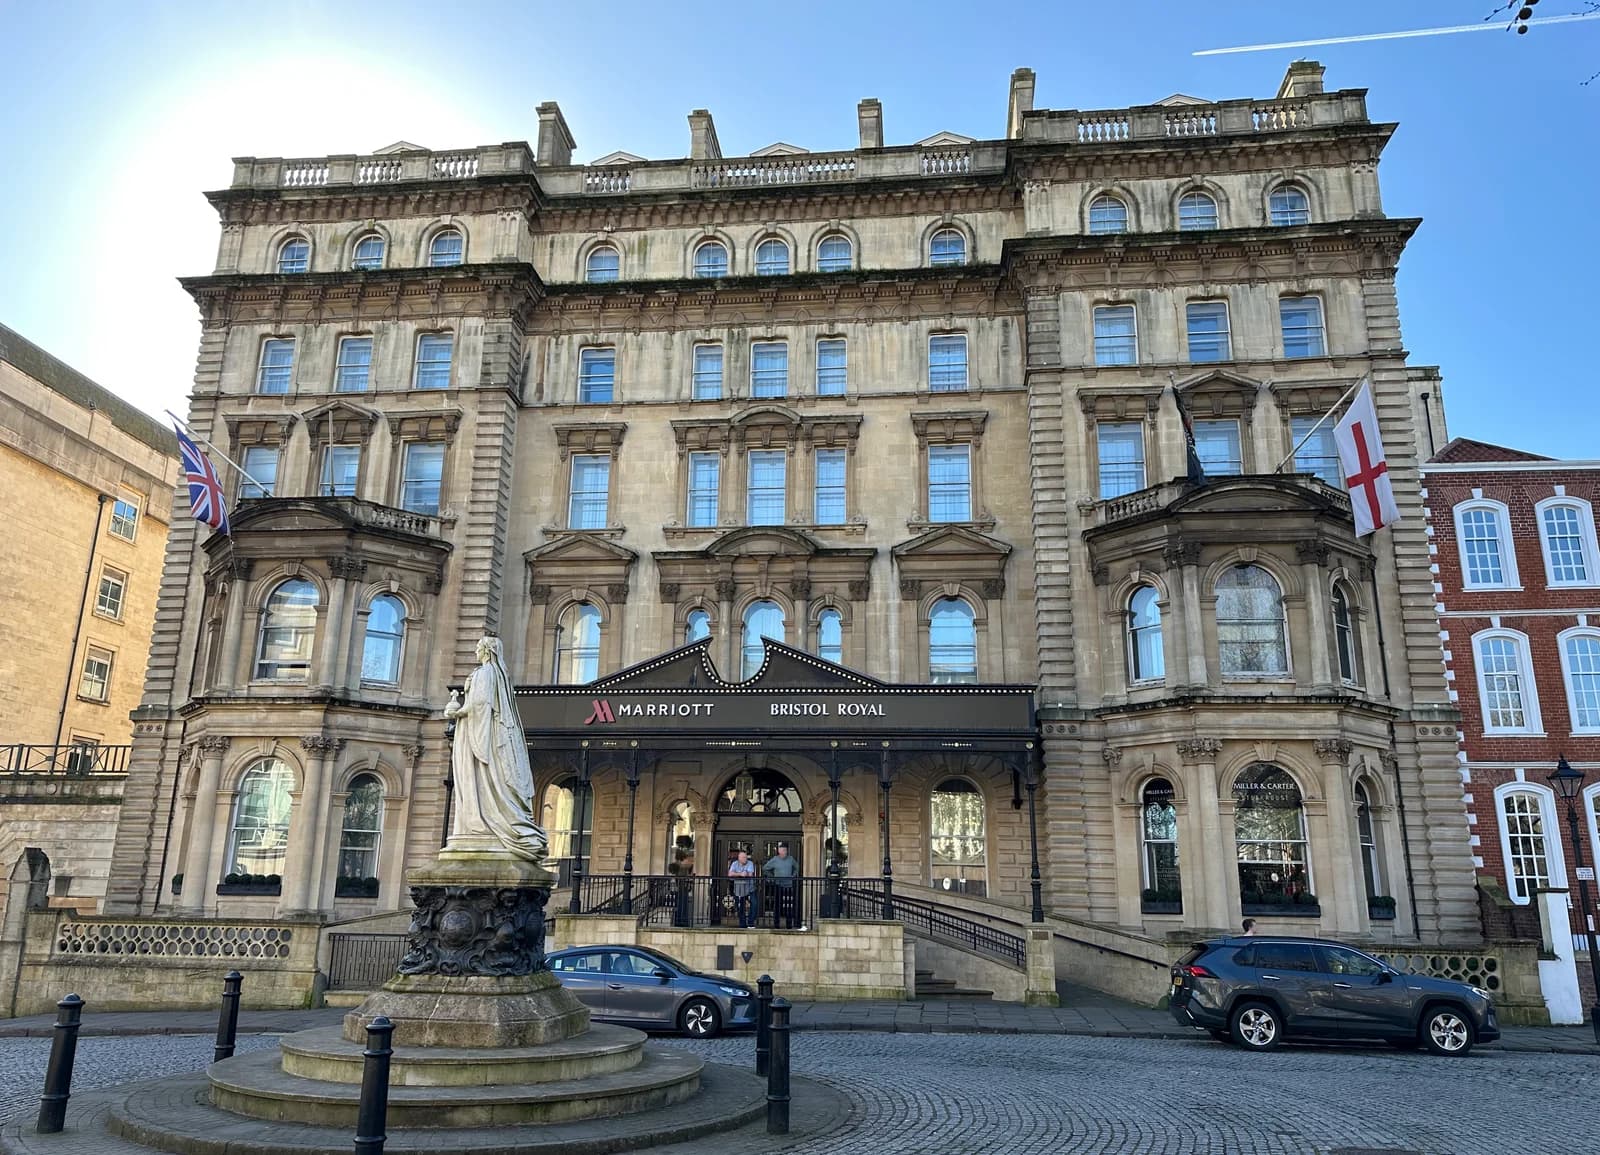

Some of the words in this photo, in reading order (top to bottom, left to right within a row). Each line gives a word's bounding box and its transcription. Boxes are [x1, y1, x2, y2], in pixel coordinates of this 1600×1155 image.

[618, 703, 714, 716] MARRIOTT
[770, 703, 829, 716] BRISTOL
[837, 703, 886, 716] ROYAL
[1233, 782, 1259, 790] MILLER
[1267, 782, 1296, 790] CARTER
